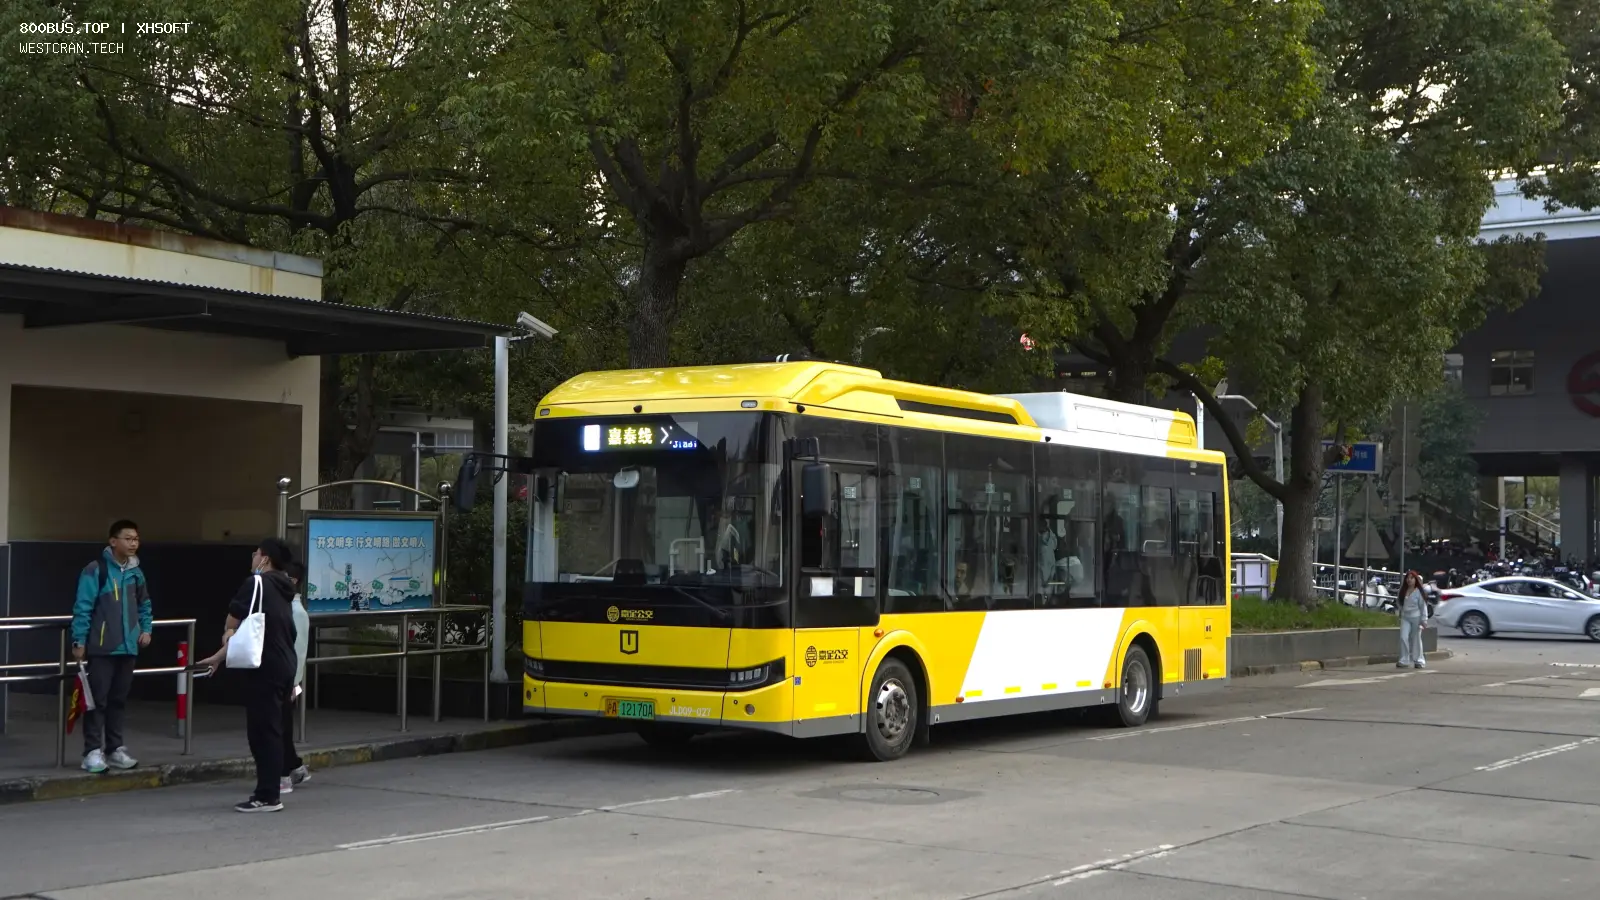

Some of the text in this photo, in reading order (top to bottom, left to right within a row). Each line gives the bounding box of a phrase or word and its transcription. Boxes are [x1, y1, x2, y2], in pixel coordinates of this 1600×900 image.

[608, 426, 653, 446] 嘉泰线
[317, 536, 354, 549] 开文明车
[356, 536, 390, 549] 行文明路
[818, 649, 849, 661] 嘉定公交
